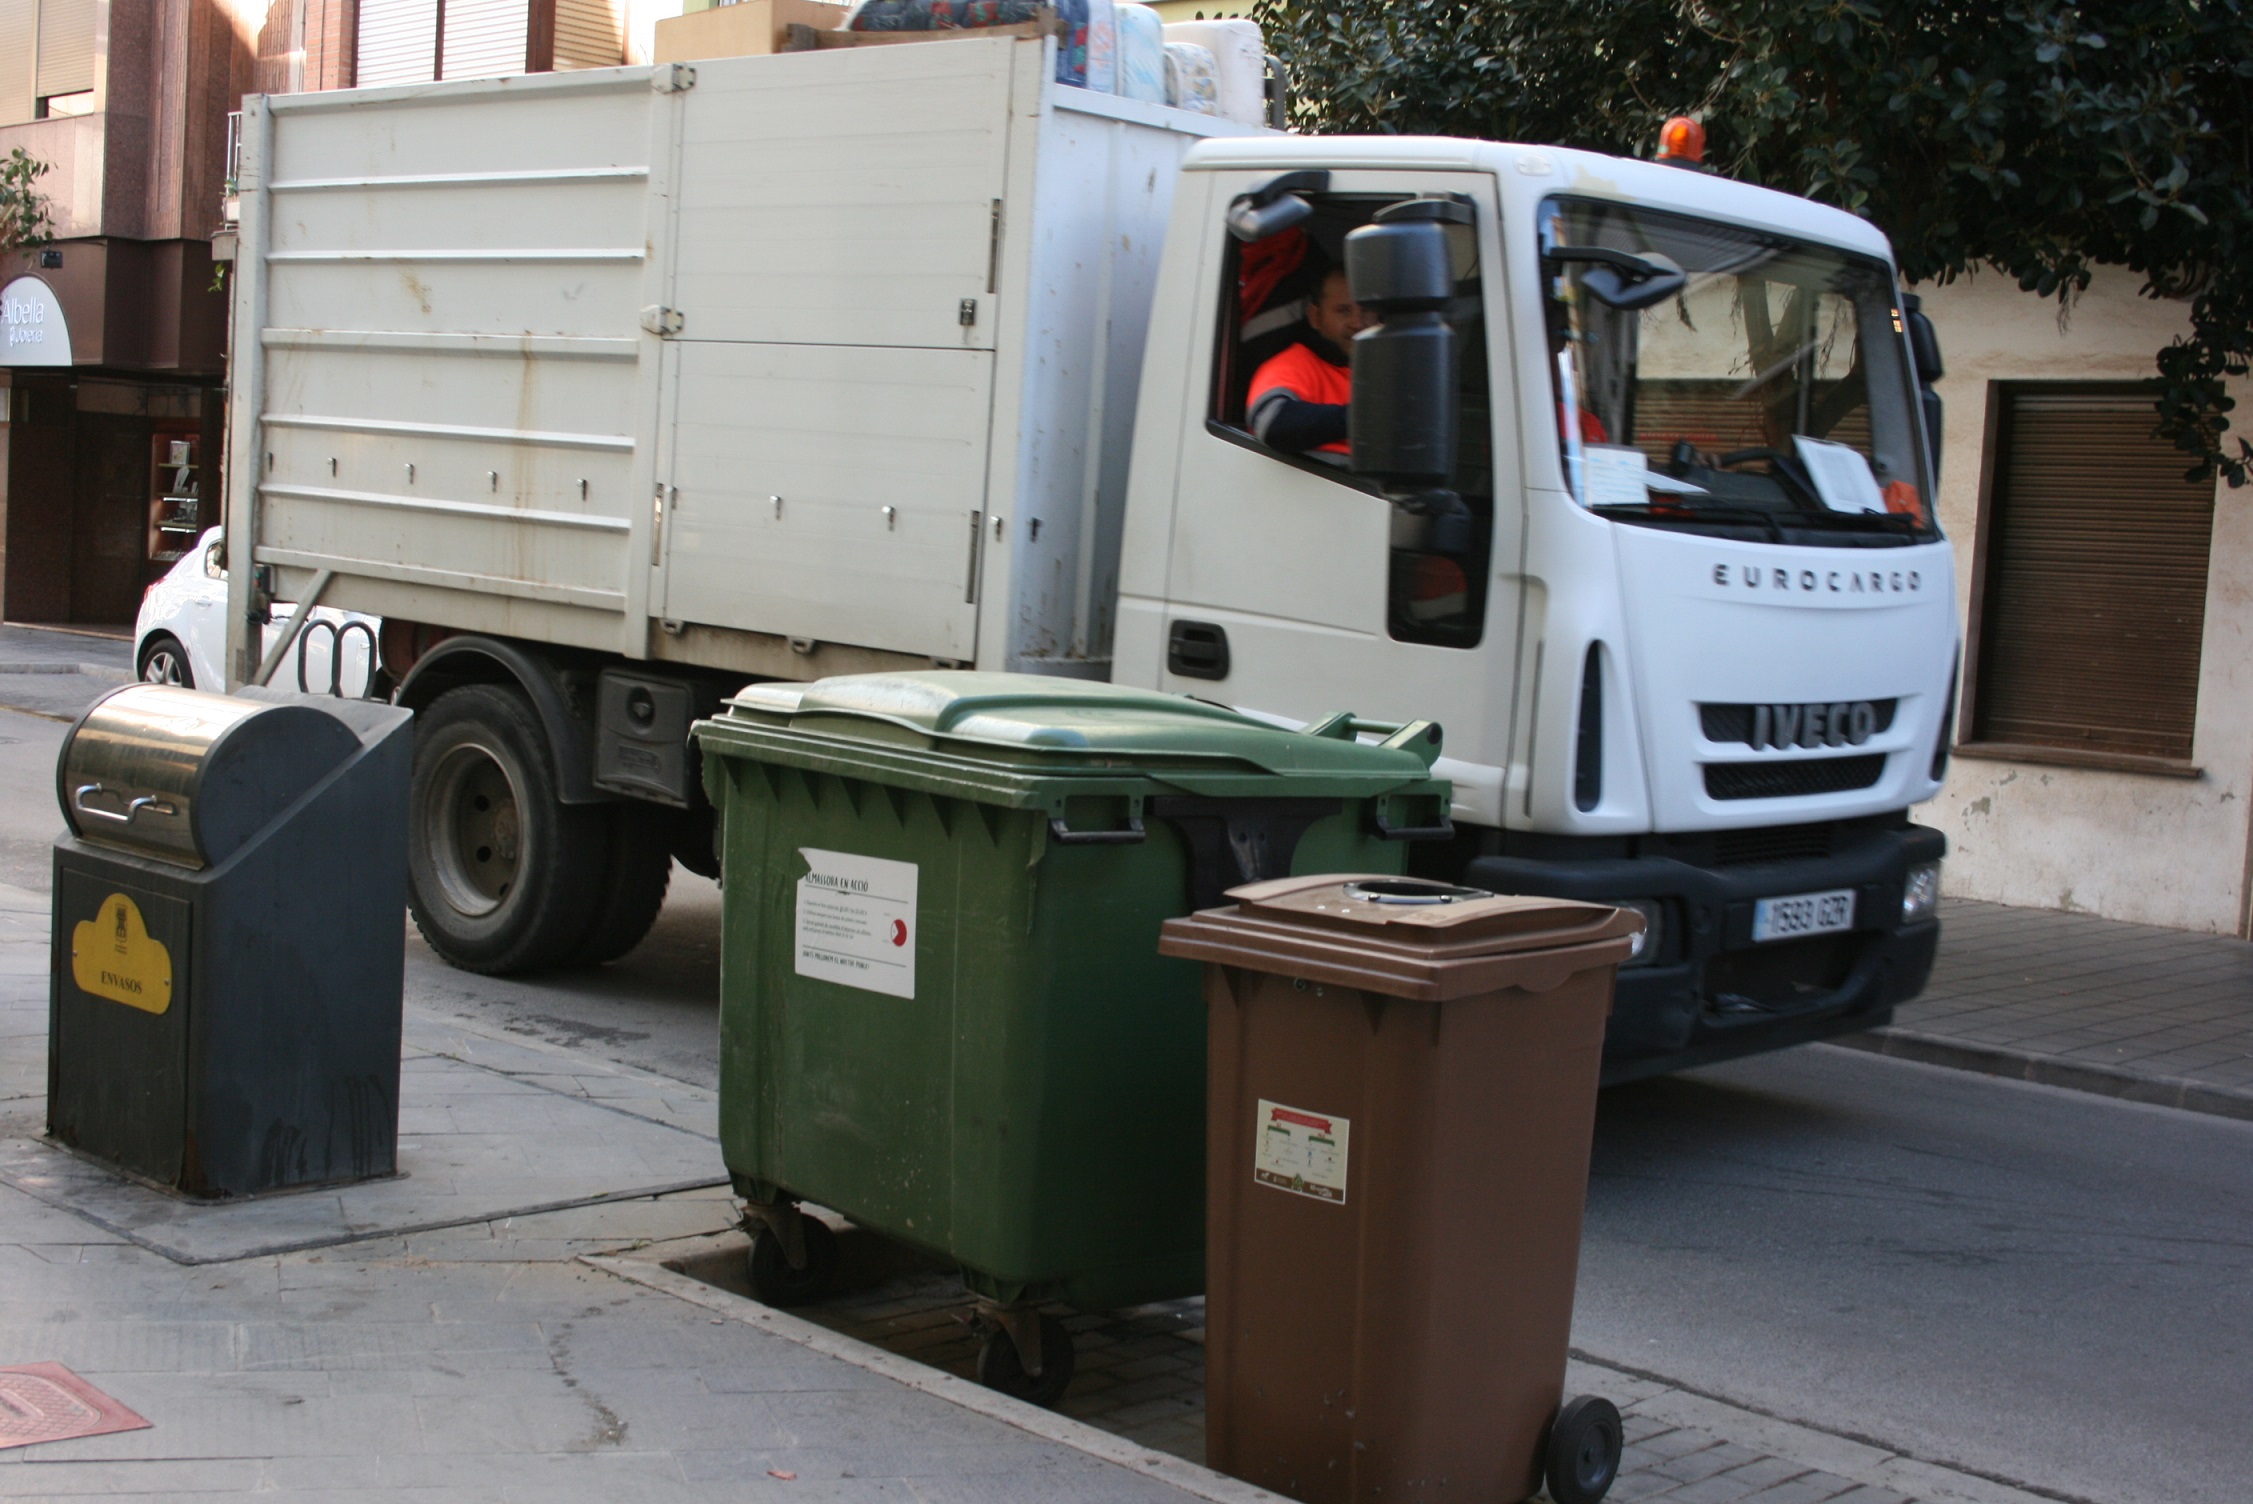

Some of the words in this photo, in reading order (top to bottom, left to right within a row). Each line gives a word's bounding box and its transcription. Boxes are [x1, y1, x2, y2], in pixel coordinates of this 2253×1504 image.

[1, 296, 45, 325] Albella
[1712, 563, 1922, 593] EUROCARGO
[1752, 702, 1877, 751] IVECO
[840, 877, 848, 889] EN
[101, 970, 142, 994] ENVASOS
